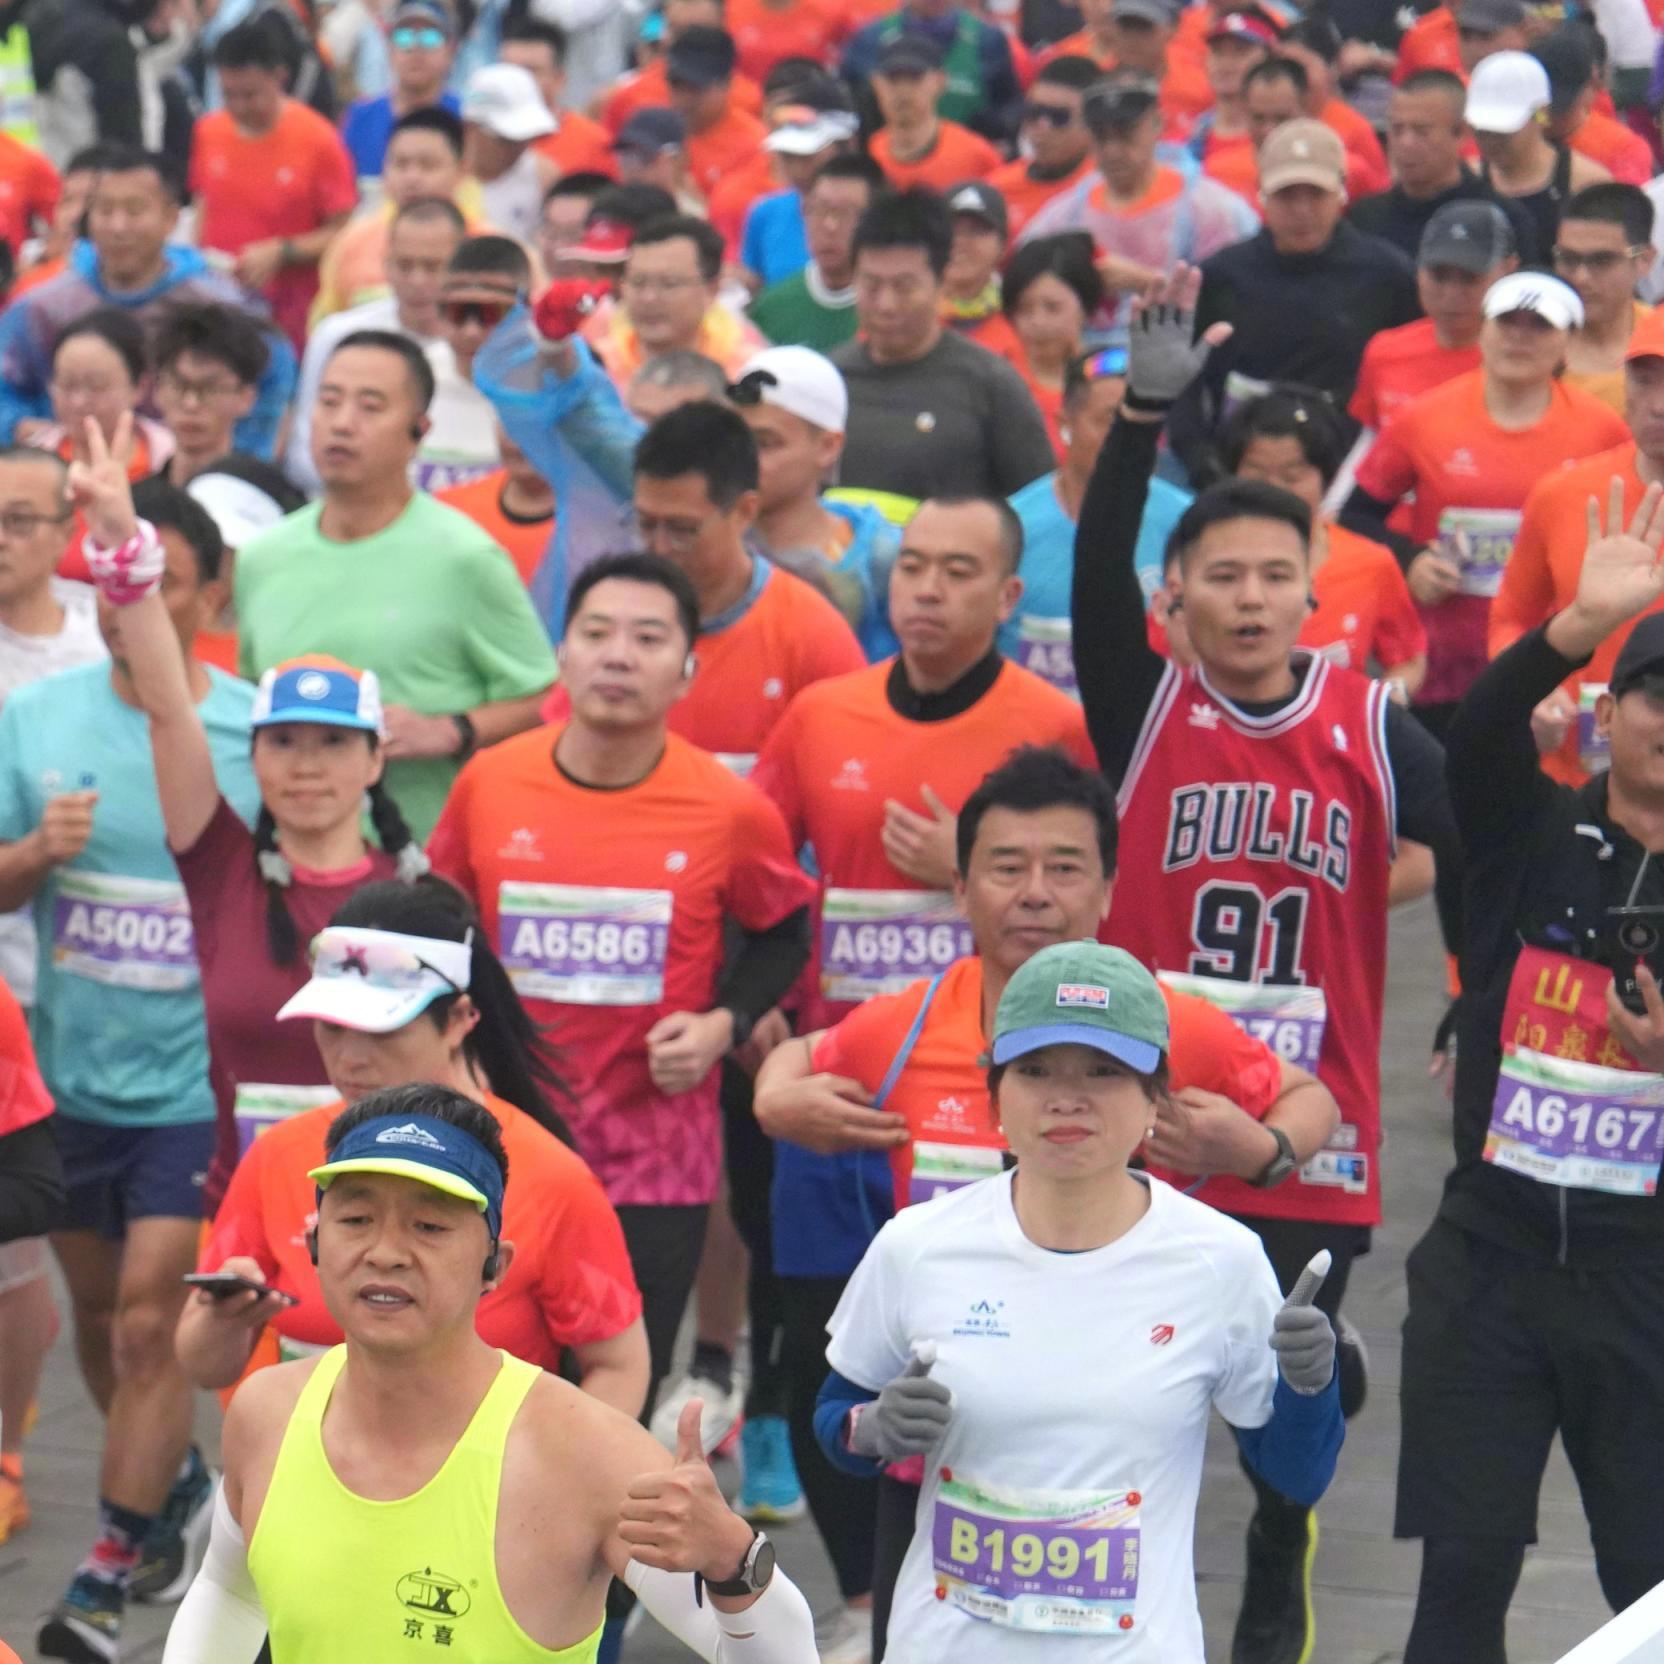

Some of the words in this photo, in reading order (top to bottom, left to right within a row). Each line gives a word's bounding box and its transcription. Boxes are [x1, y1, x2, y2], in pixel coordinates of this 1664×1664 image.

[1162, 783, 1352, 894] BULLS
[65, 903, 193, 956] A5002
[513, 918, 650, 965] A6586
[830, 923, 956, 965] A6936
[1189, 878, 1310, 988] 91
[1534, 963, 1584, 1014] 山
[1503, 1086, 1655, 1151] A6167
[950, 1516, 1111, 1582] B1991
[403, 1618, 454, 1647] 京喜
